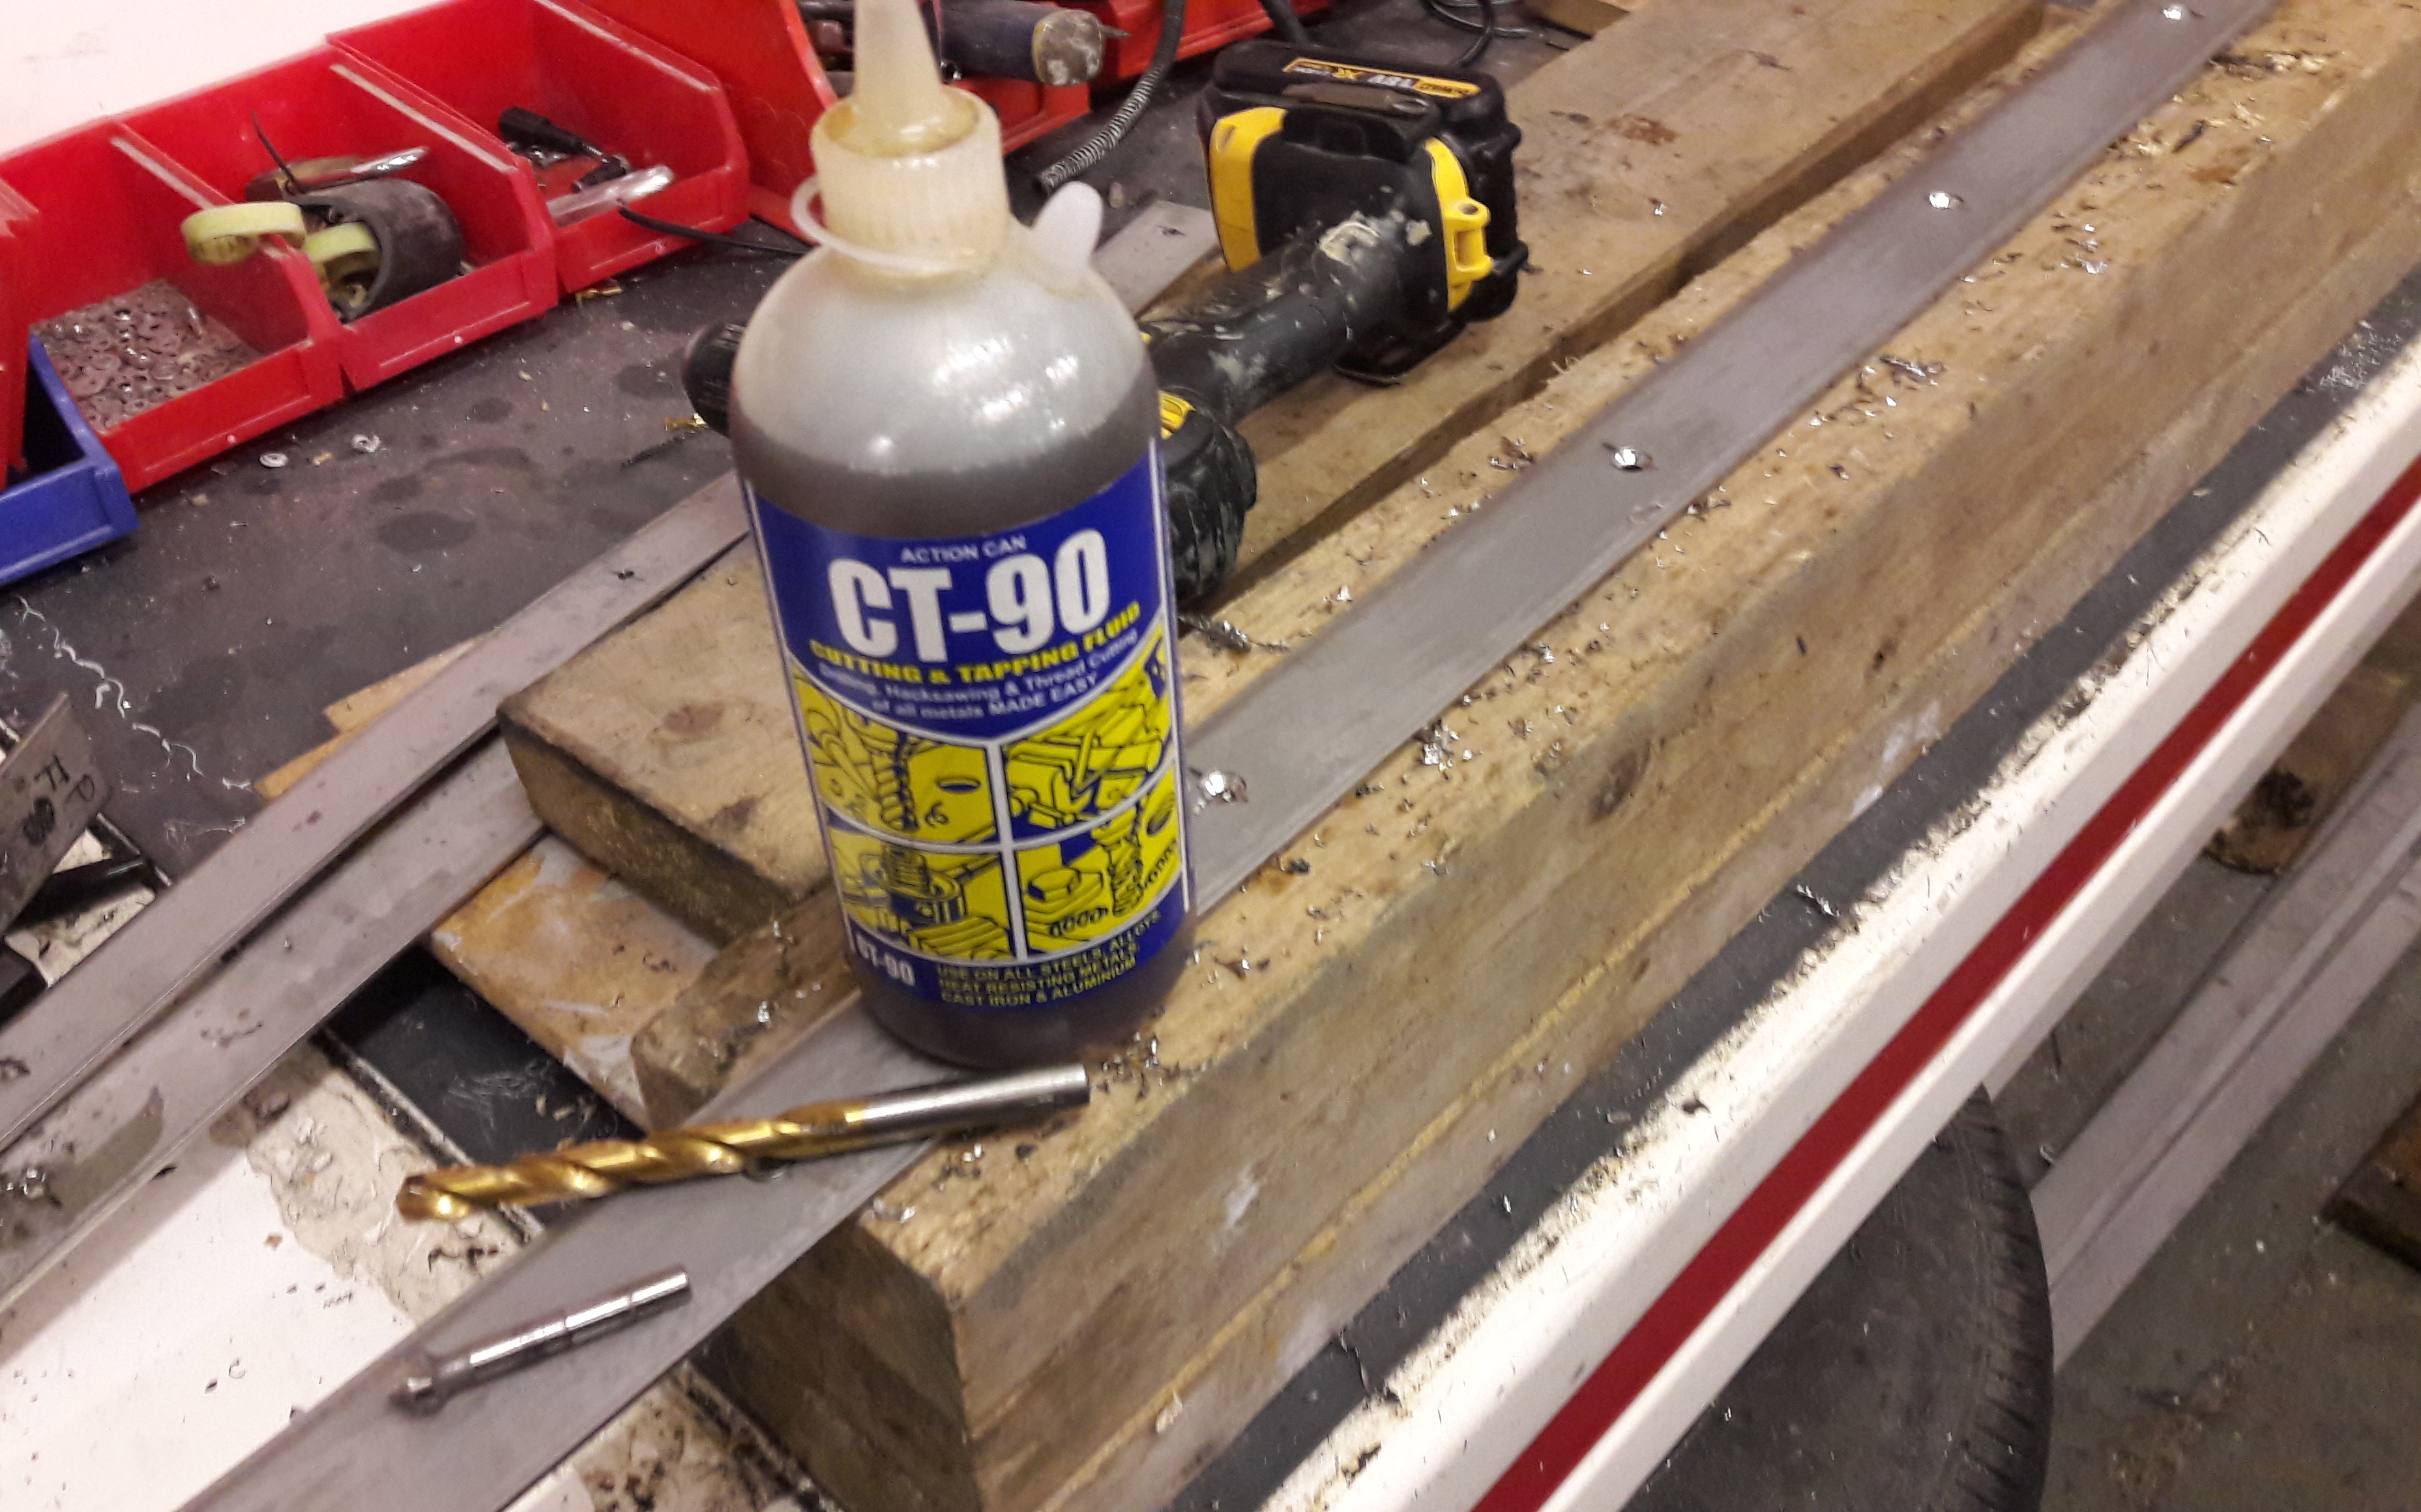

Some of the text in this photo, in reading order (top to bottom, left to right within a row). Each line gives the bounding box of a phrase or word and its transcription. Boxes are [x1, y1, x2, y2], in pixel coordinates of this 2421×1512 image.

[901, 533, 1027, 564] ACTION CAN
[827, 529, 1111, 663] CT-90
[809, 639, 923, 684] CUTTING
[928, 669, 952, 684] &
[956, 640, 1079, 684] TAPPING
[1082, 601, 1139, 652] FLUID
[885, 684, 1001, 704] Hacksawing
[1023, 658, 1086, 692] Thread
[988, 692, 1046, 716] MADE
[1049, 669, 1098, 702] EASY
[984, 971, 1076, 994] RESISTING
[988, 993, 1032, 1007] IRON
[1051, 953, 1136, 1001] ALUMINIUM
[1003, 967, 1034, 981] ALL
